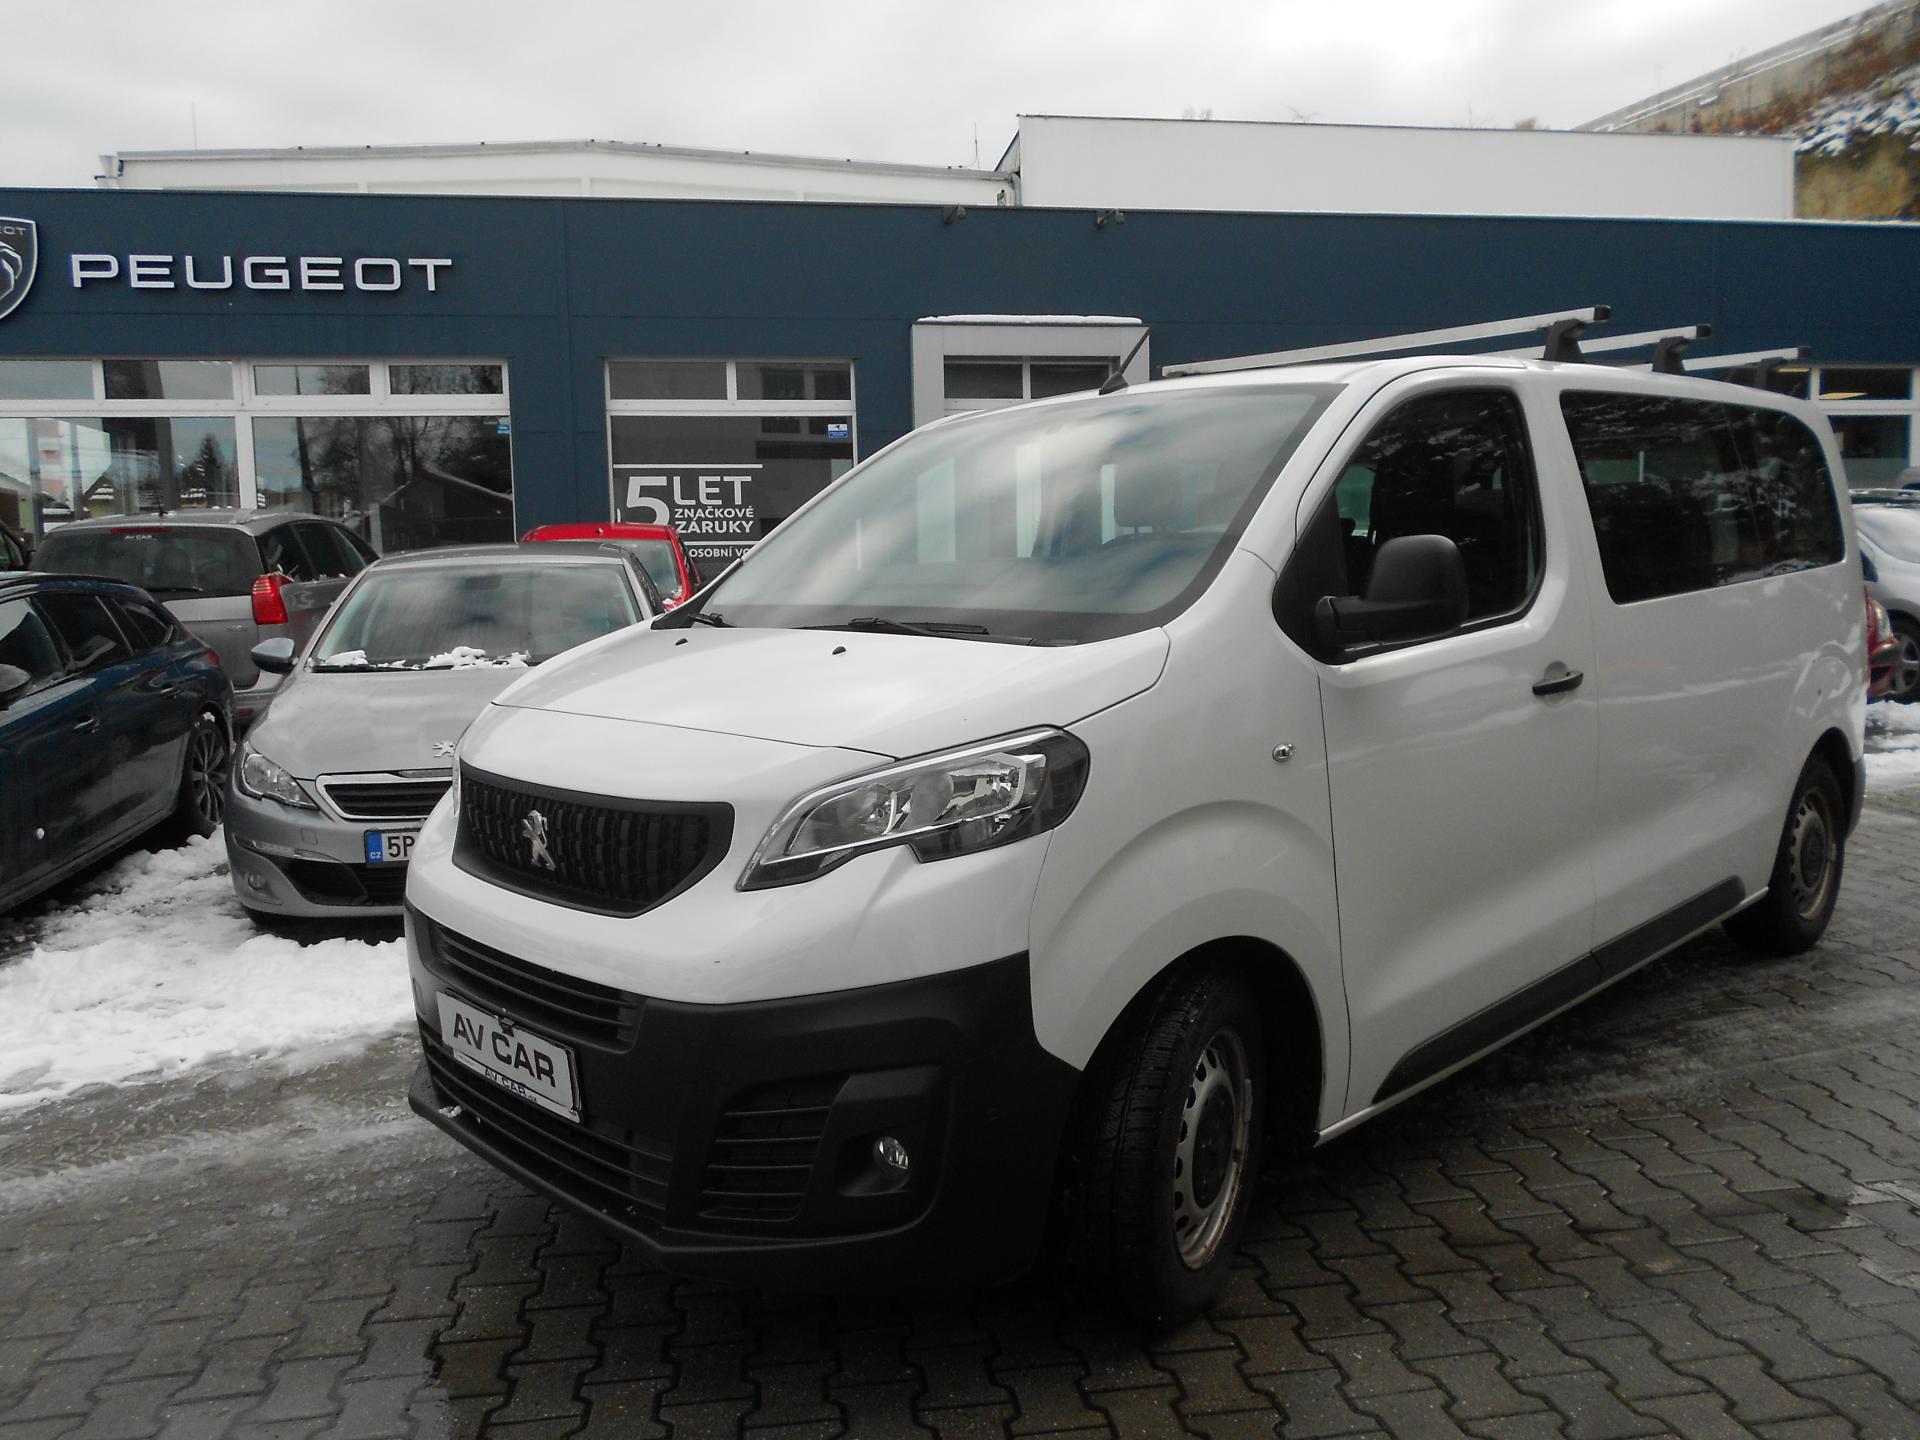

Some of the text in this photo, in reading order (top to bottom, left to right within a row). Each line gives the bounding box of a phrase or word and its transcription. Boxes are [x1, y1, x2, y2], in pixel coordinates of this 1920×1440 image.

[0, 226, 27, 237] OT
[72, 253, 453, 292] PEUGEOT
[626, 476, 752, 526] 5 LET
[674, 506, 755, 519] ZNAČKOVÉ
[674, 515, 755, 534] ZÁRUKY
[689, 546, 733, 558] OSOBNÍ
[370, 851, 382, 859] CZ
[387, 835, 416, 858] 5P
[453, 1012, 557, 1088] AV CAR
[501, 1077, 527, 1097] CAR
